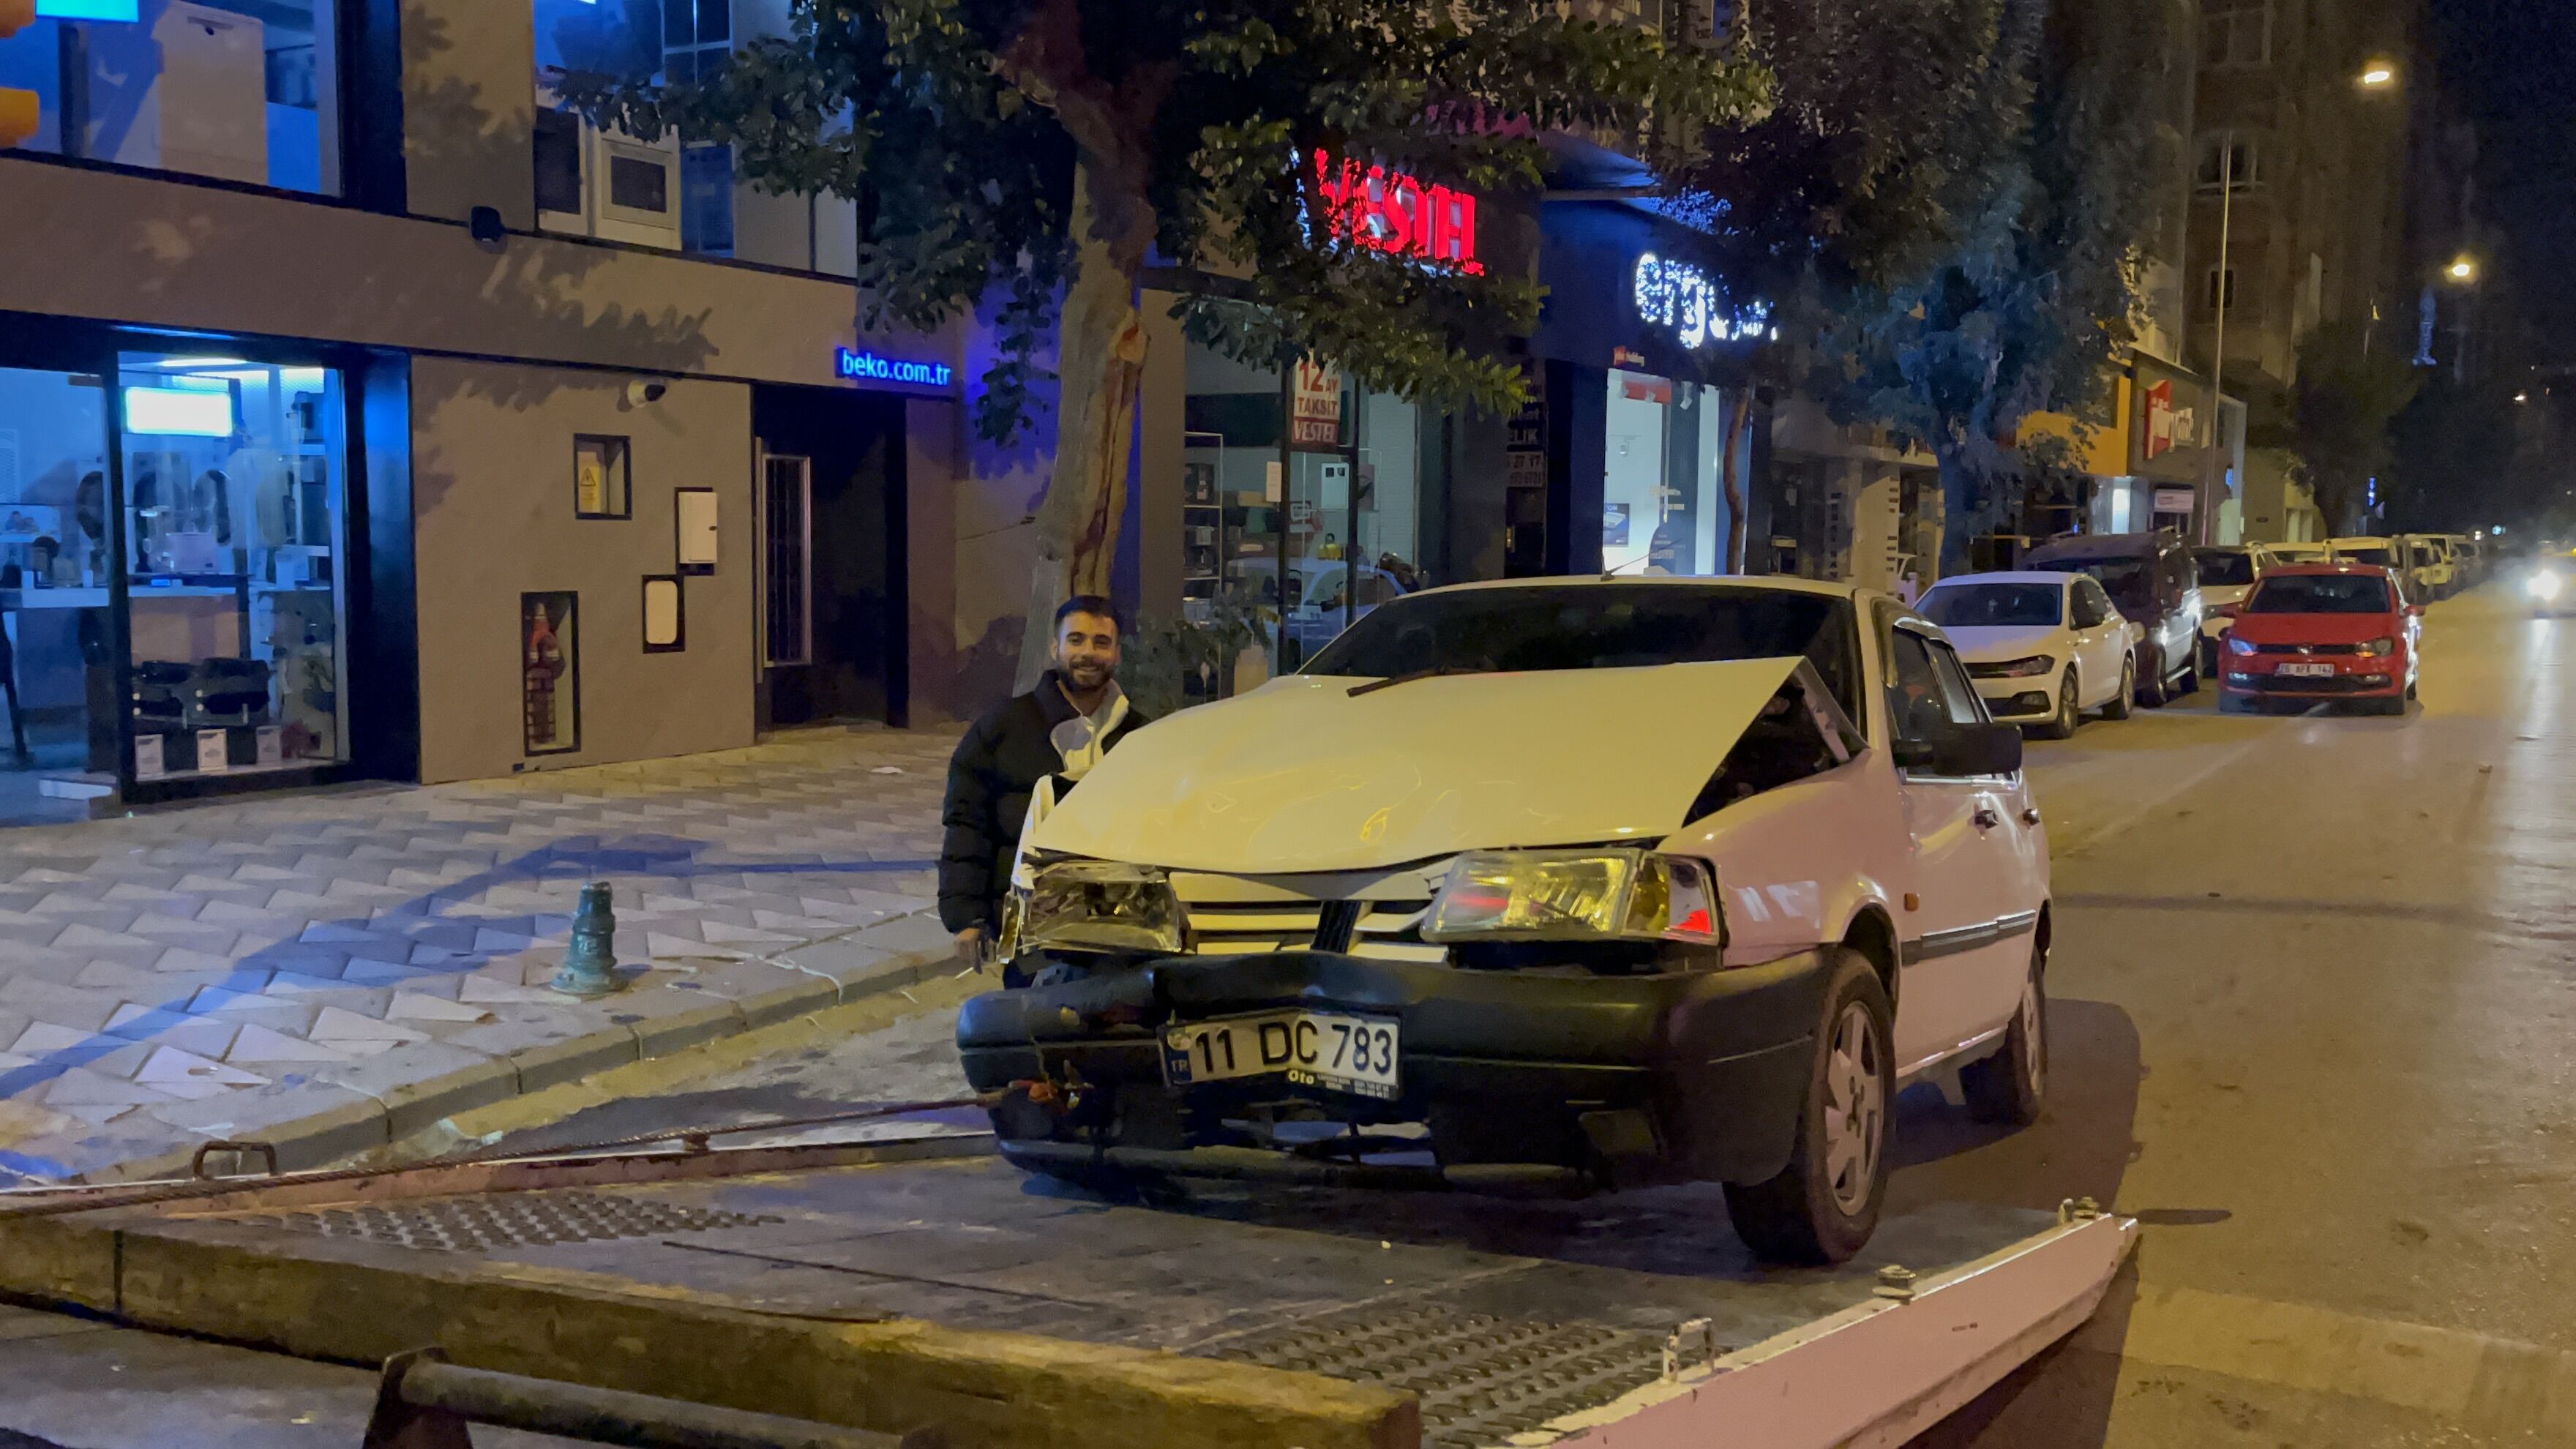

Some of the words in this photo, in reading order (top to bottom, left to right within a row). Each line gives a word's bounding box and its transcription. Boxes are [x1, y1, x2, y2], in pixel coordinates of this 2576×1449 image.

[842, 349, 951, 386] beko.com.tr
[1299, 362, 1324, 392] 12
[1294, 420, 1336, 442] VESTEL
[1195, 1028, 1235, 1074] 11
[1258, 1020, 1317, 1066] DC
[1331, 1024, 1391, 1076] 783
